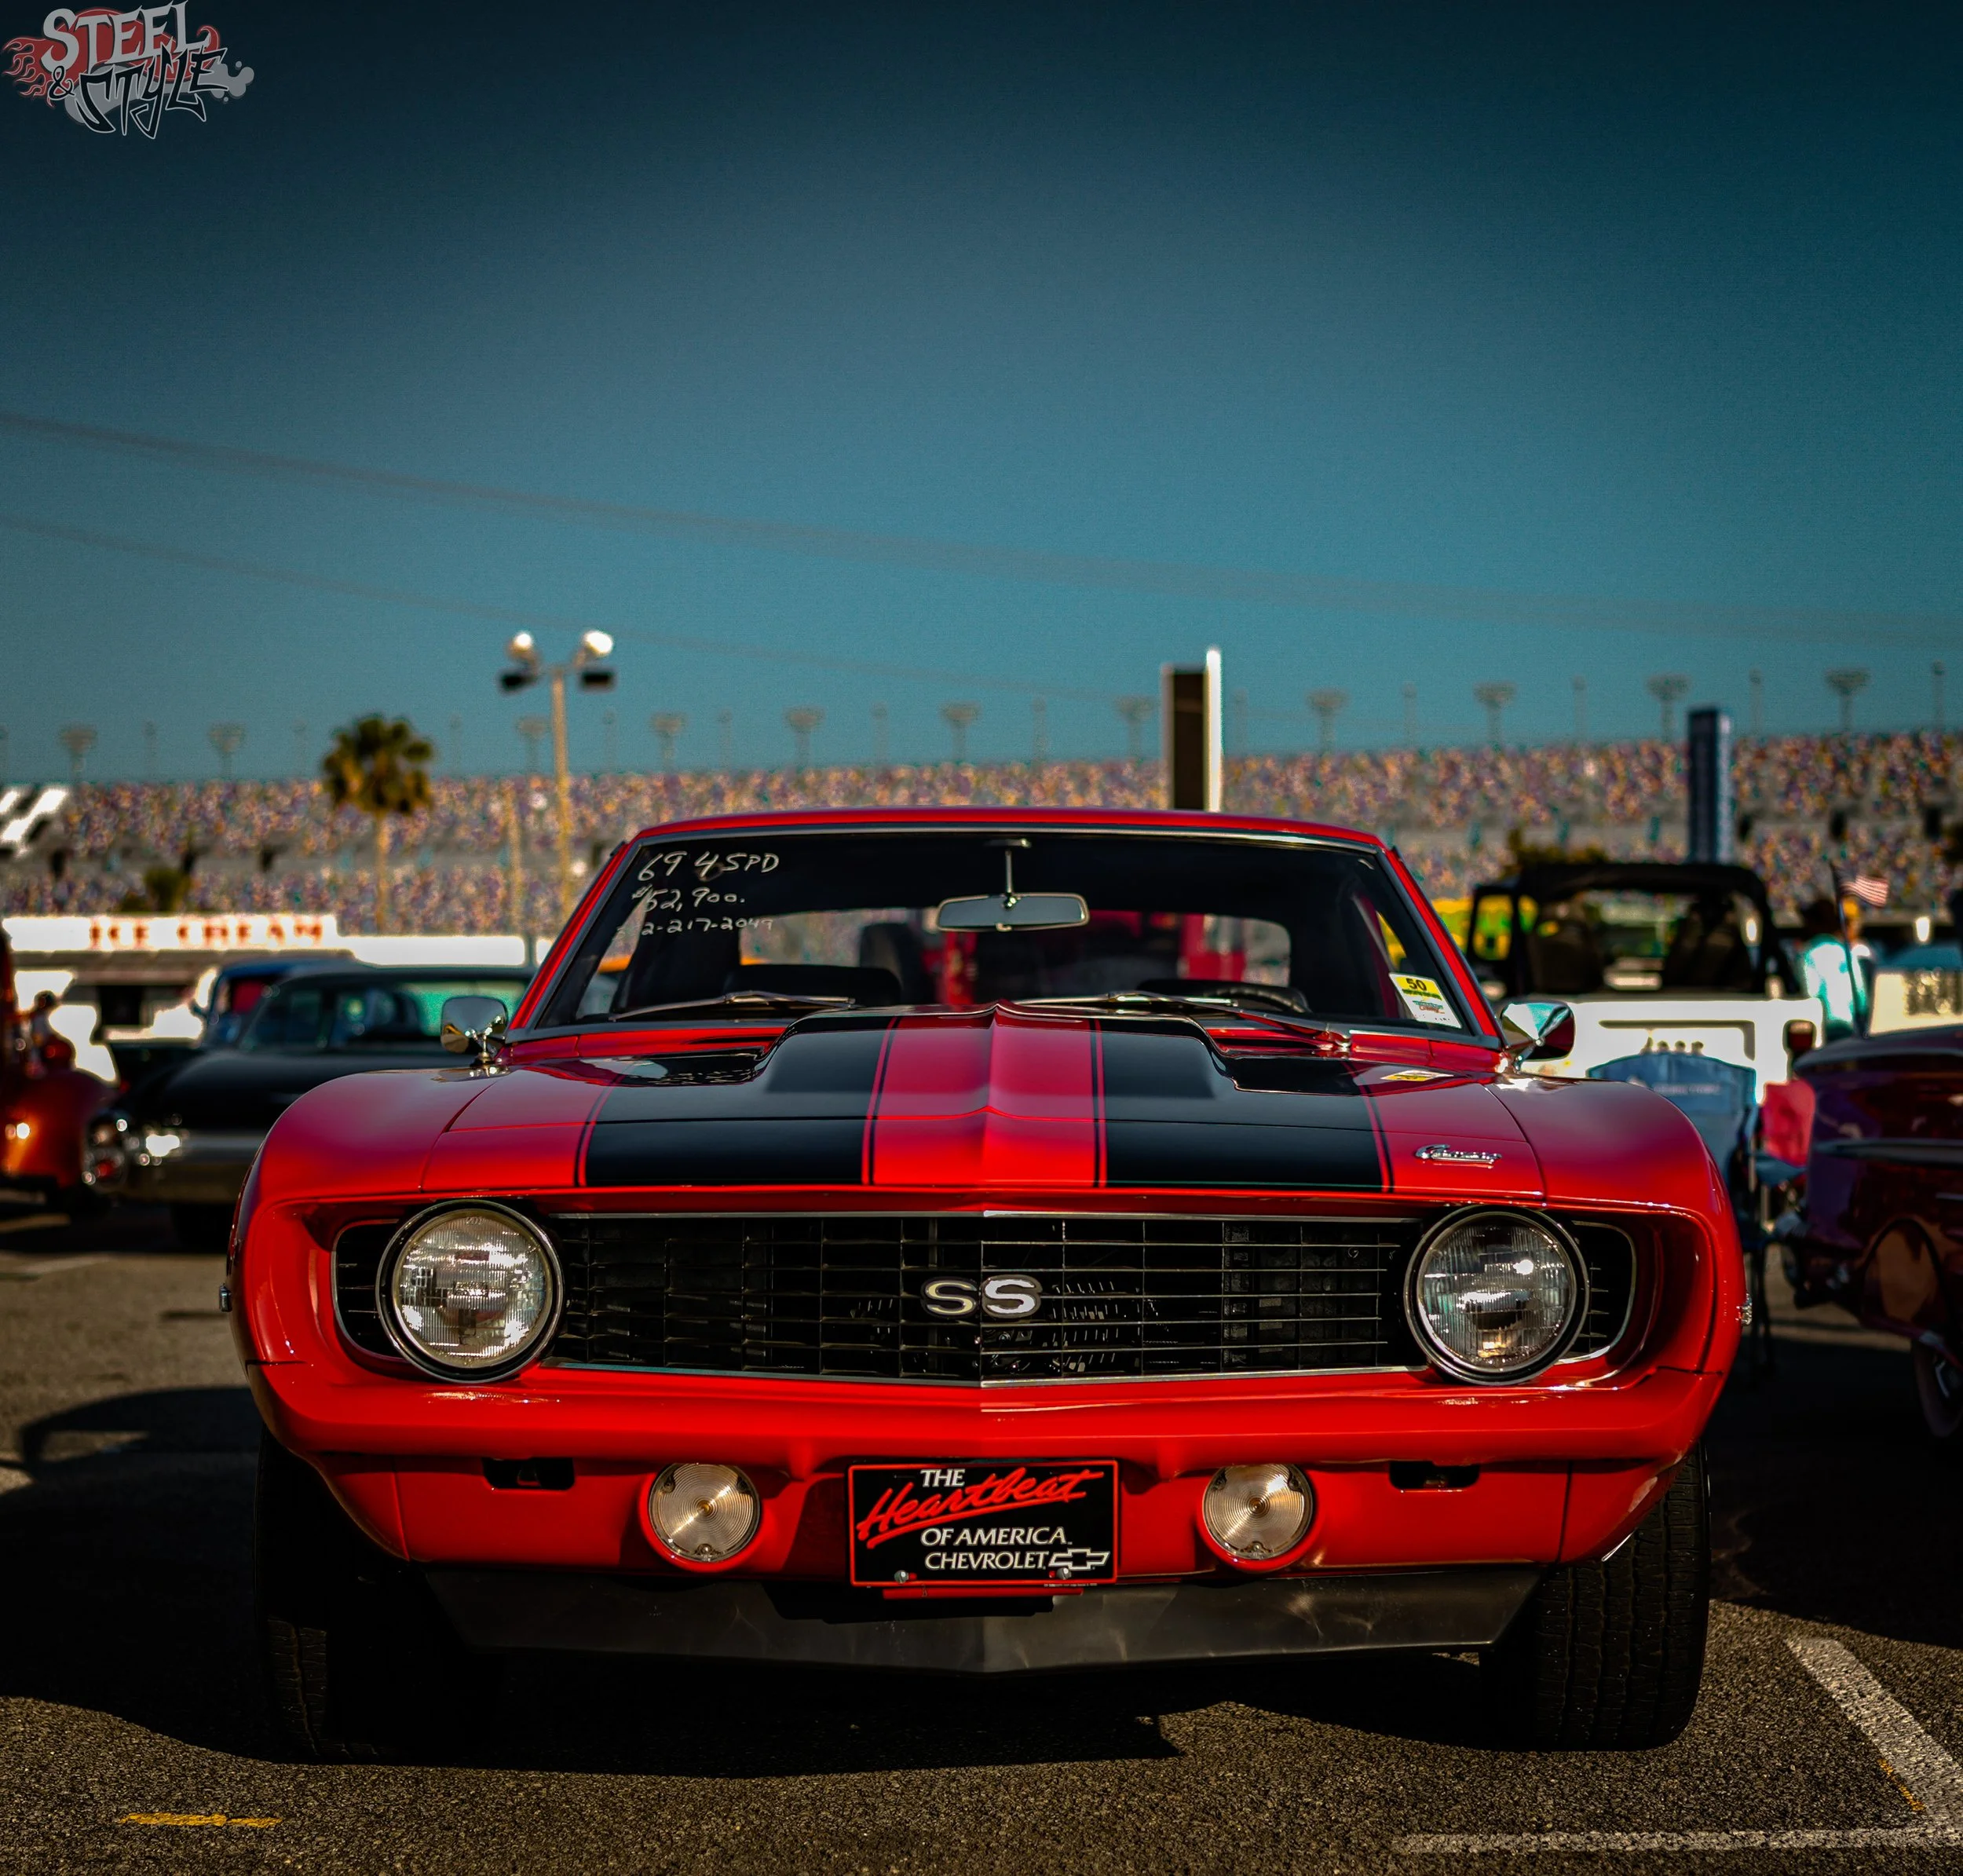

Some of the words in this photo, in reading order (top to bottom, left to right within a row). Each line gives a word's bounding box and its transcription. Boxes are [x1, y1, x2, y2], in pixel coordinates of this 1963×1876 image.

[638, 850, 687, 881] 69
[89, 915, 149, 949] ICE
[176, 915, 323, 949] CREAM
[616, 916, 773, 936] 2-217-2049
[1406, 978, 1427, 991] 50
[921, 1274, 1043, 1318] SS
[920, 1468, 966, 1488] THE
[857, 1467, 1105, 1541] Heartbeat
[920, 1528, 954, 1546] OF
[954, 1527, 1067, 1545] AMERICA
[925, 1551, 1049, 1570] CHEVROLET
